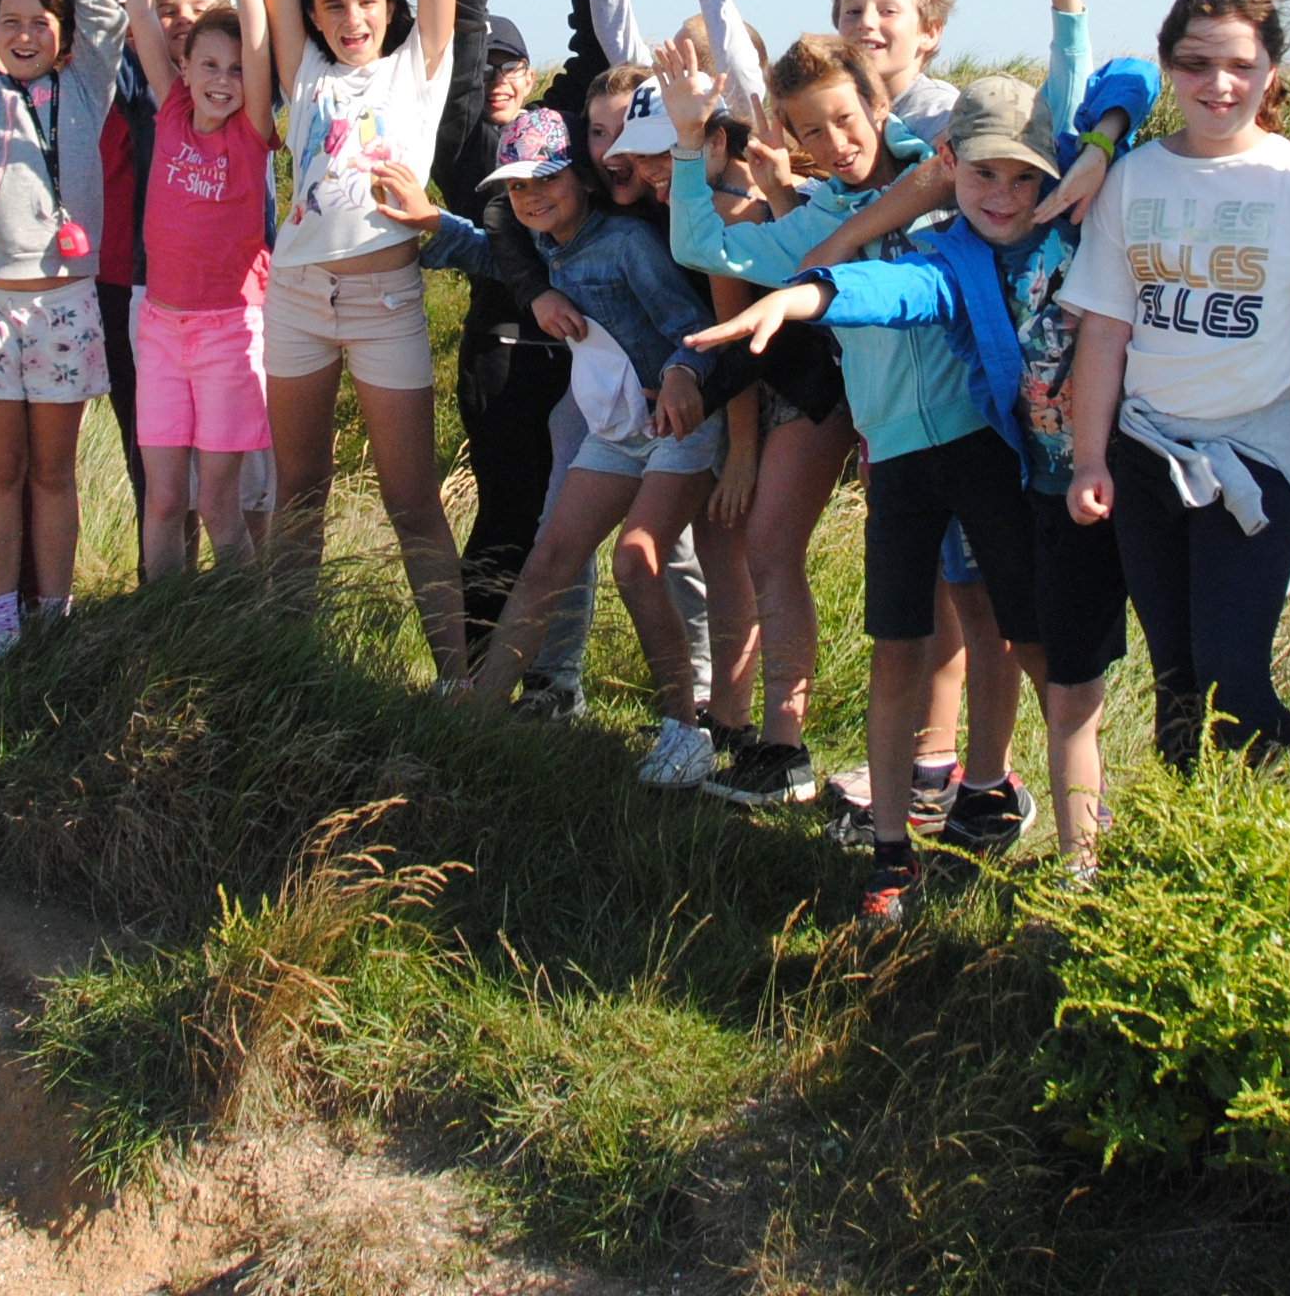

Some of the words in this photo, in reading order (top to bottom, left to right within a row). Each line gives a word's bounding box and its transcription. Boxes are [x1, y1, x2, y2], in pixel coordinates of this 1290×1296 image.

[627, 86, 656, 120] H
[1125, 198, 1275, 243] ELLES
[1126, 242, 1270, 292] ELLES
[1139, 283, 1264, 339] ELLES
